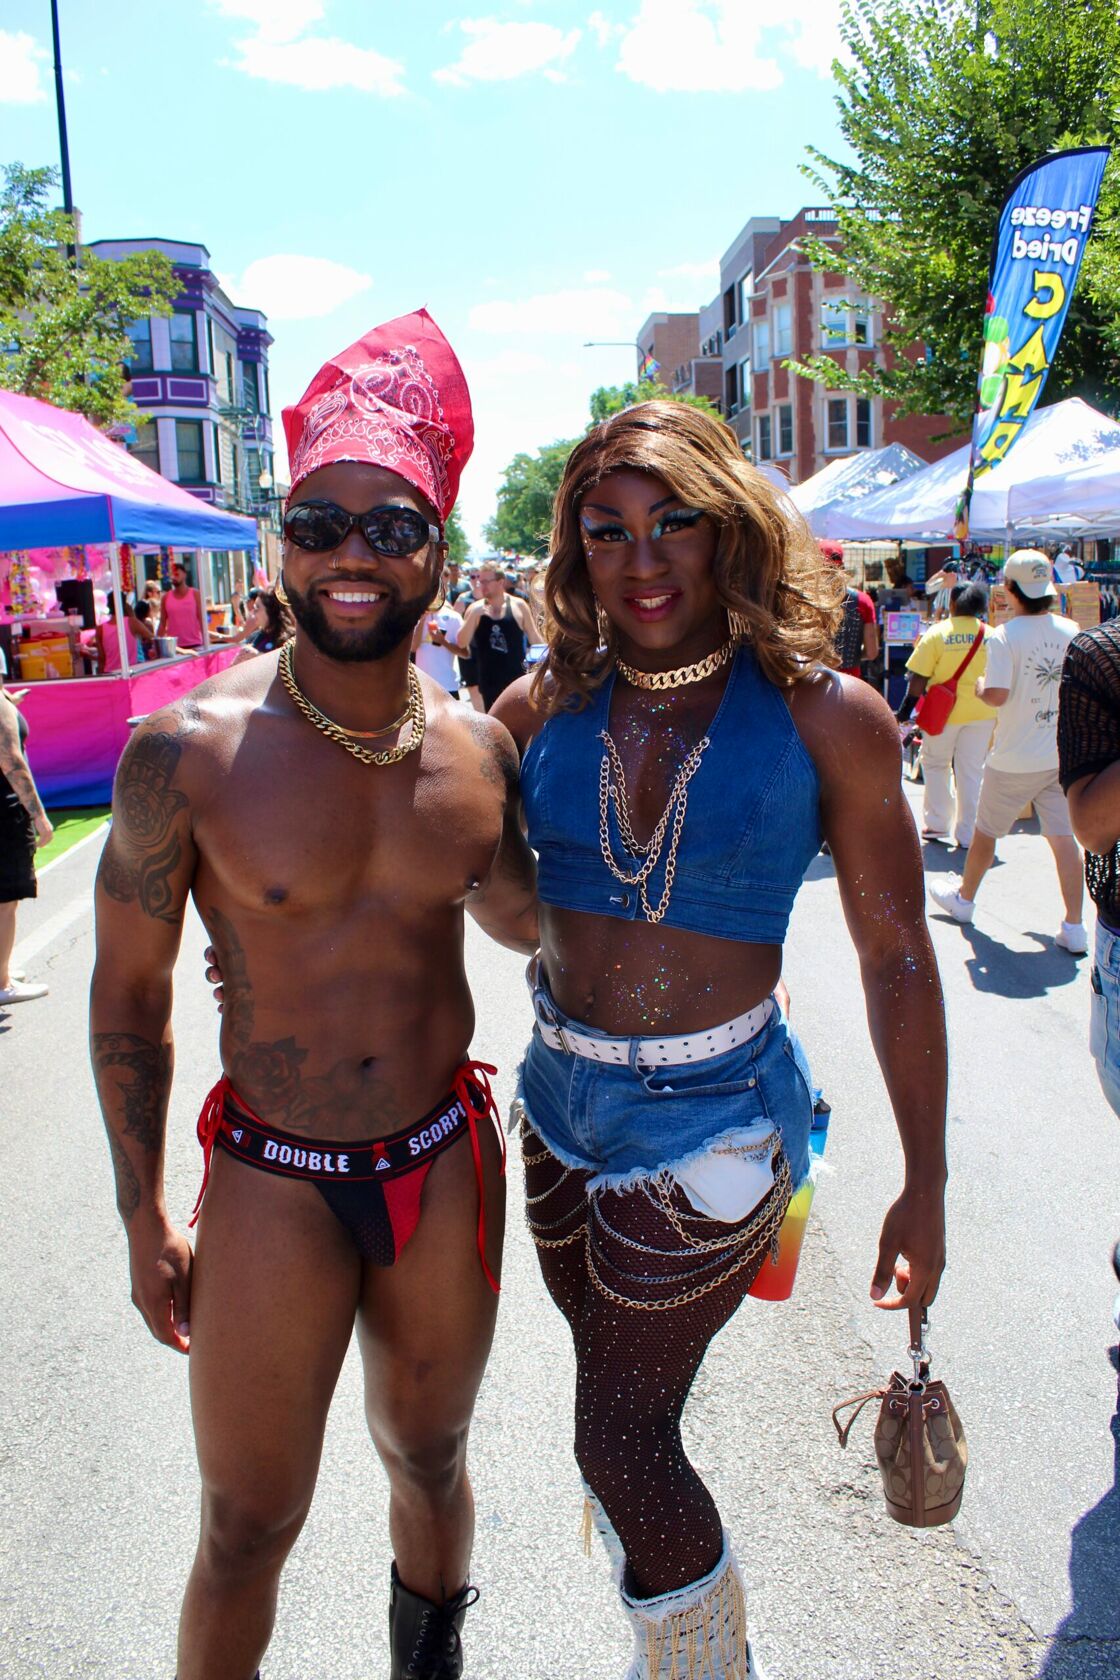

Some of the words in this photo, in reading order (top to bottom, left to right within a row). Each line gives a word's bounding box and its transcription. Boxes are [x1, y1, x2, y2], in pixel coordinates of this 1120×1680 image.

[945, 633, 989, 646] SECURY
[263, 1139, 350, 1173] DOUBLE
[408, 1101, 468, 1156] SCORPI
